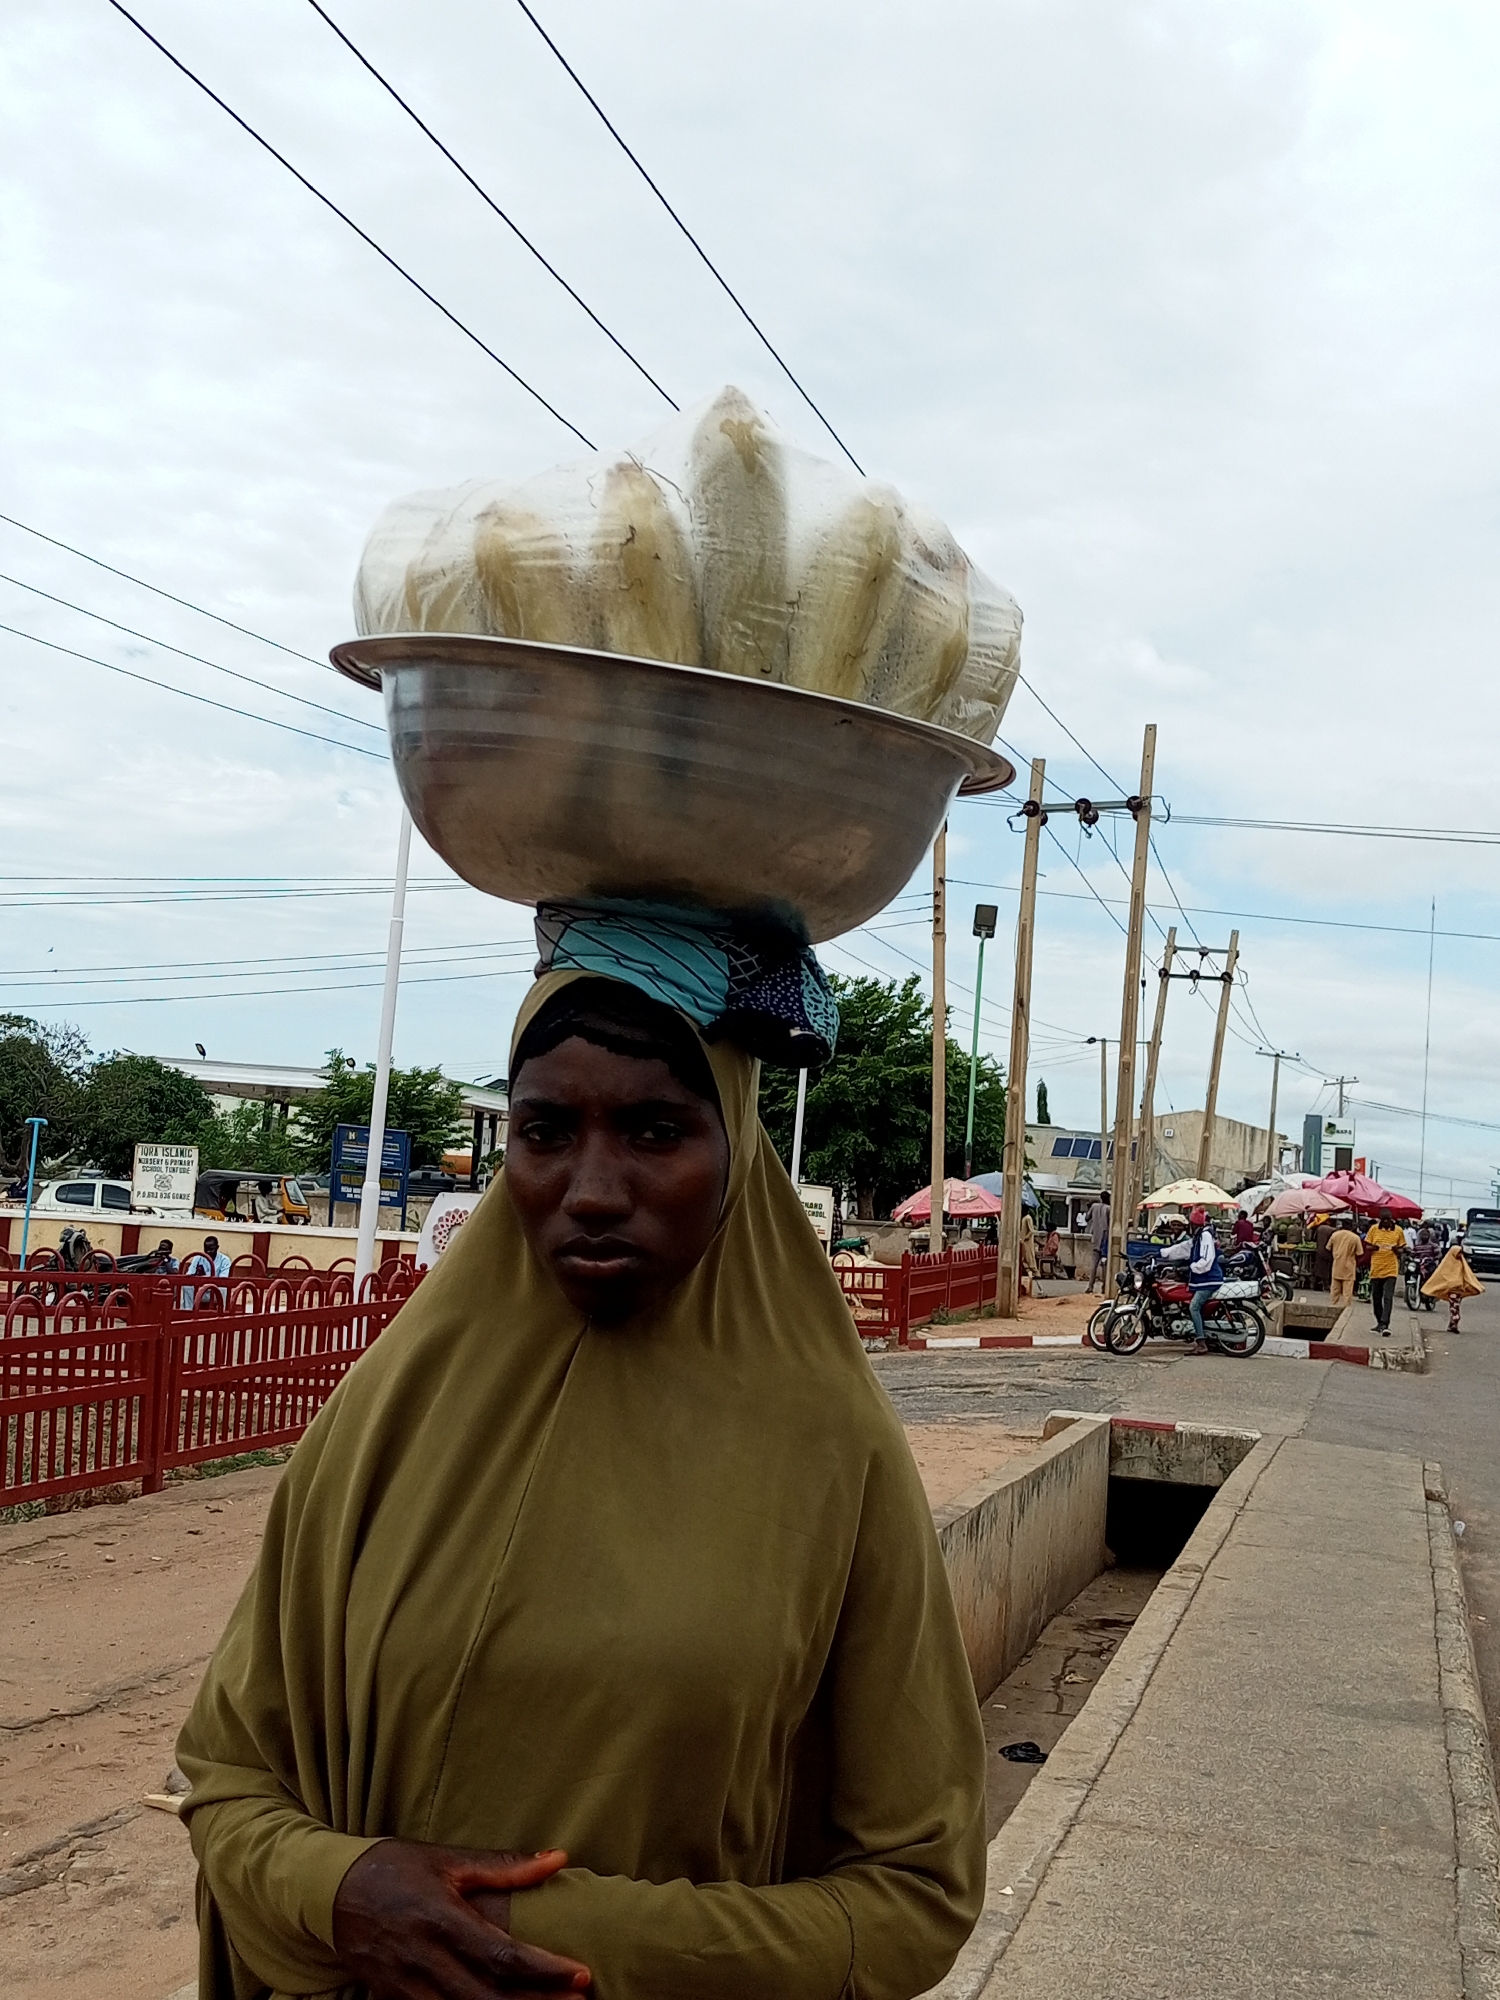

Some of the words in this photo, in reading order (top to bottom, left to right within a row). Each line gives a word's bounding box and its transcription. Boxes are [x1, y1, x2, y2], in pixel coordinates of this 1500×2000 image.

[141, 1146, 158, 1157] IQRA
[162, 1147, 193, 1158] ISLAMIC
[801, 1202, 823, 1210] NARD
[805, 1210, 827, 1219] CHOOL
